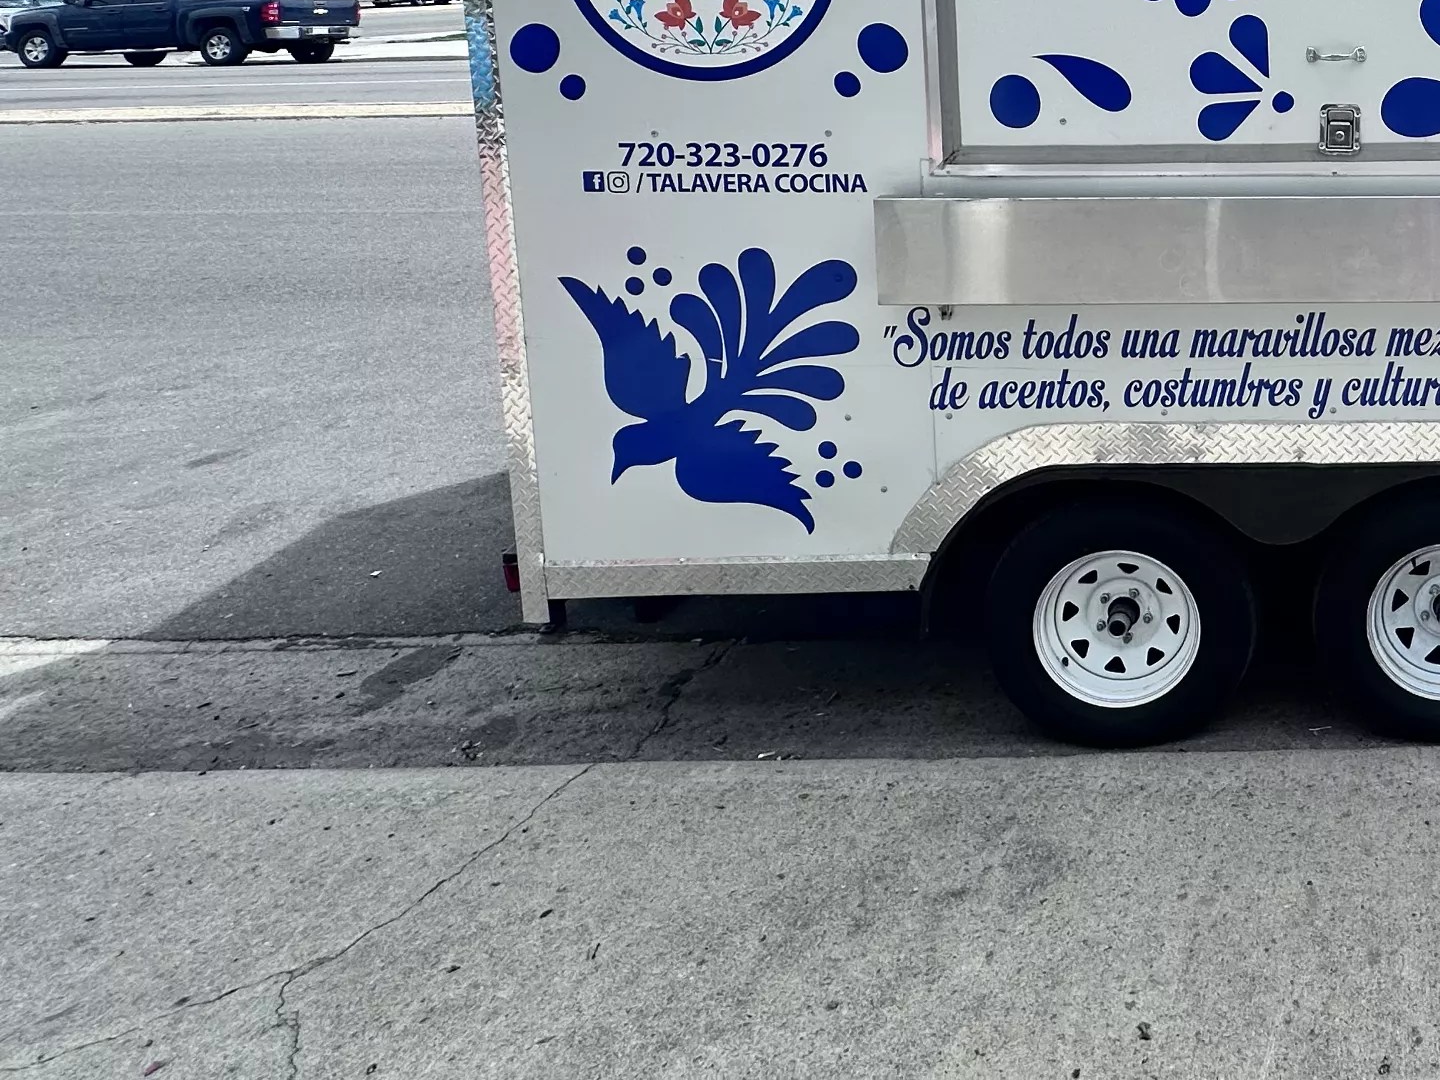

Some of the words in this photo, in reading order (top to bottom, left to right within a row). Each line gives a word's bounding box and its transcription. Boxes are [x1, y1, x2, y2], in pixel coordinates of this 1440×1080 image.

[618, 142, 828, 167] 720-323-0276
[648, 173, 769, 193] TALAVERA
[775, 173, 867, 193] COCINA
[1022, 314, 1111, 359] todos
[1121, 328, 1181, 358] una
[1190, 311, 1377, 358] maravillosa
[929, 367, 970, 410] de
[978, 369, 1110, 412] acentos,
[1124, 362, 1303, 408] costumbres
[1308, 378, 1333, 419] y
